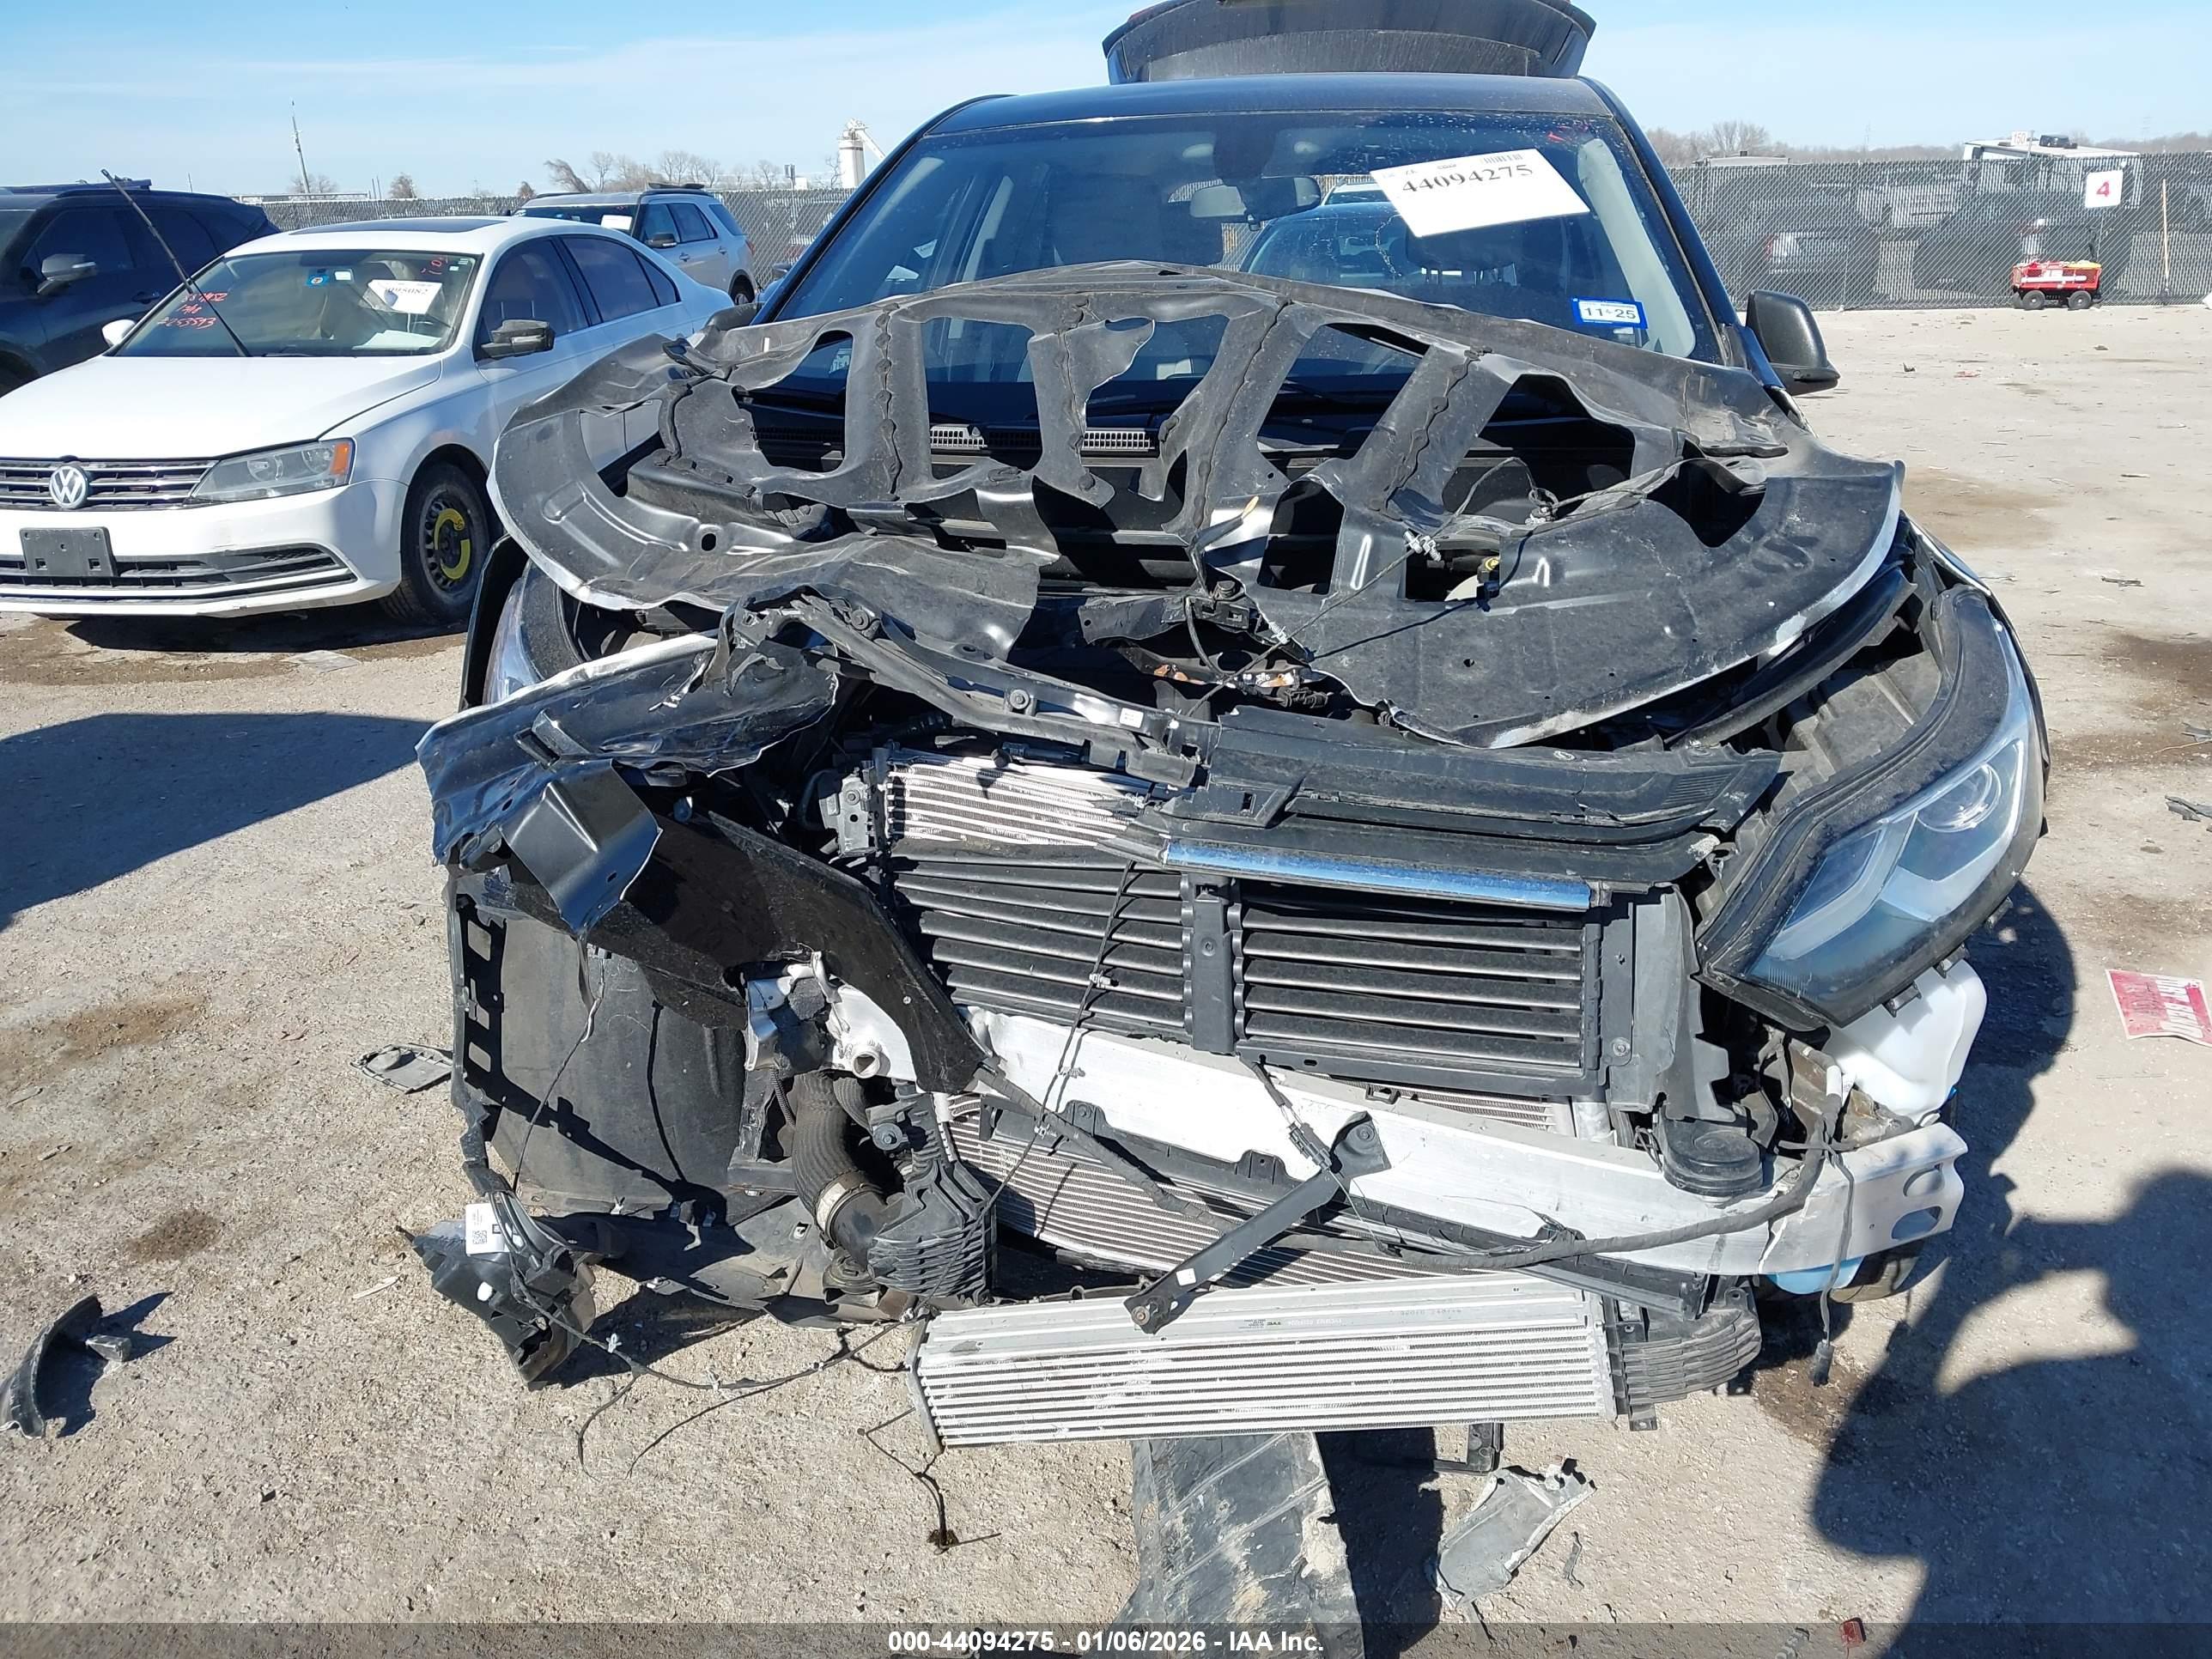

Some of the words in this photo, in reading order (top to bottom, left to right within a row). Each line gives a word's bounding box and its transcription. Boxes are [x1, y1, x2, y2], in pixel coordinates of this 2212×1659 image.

[1402, 164, 1534, 191] 44094275
[2096, 181, 2110, 198] 4
[1584, 307, 1604, 316] 11
[1614, 309, 1636, 319] 25
